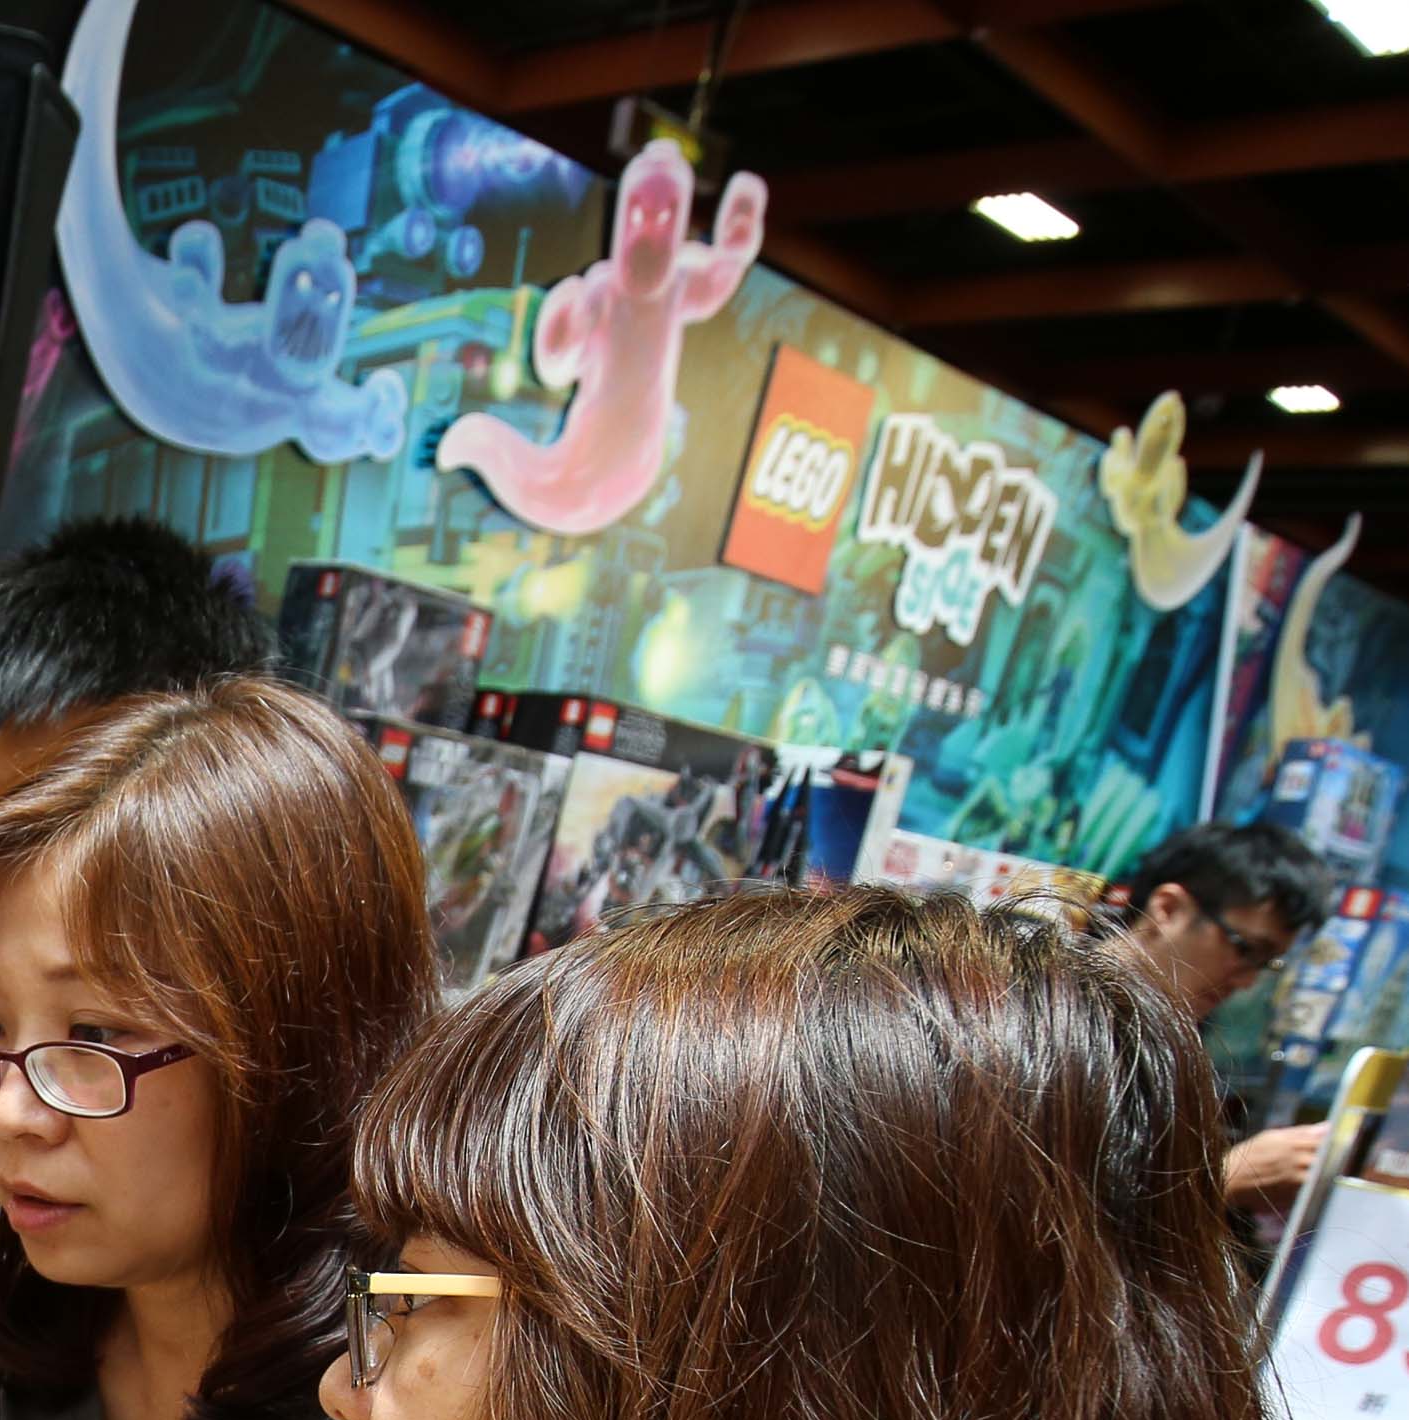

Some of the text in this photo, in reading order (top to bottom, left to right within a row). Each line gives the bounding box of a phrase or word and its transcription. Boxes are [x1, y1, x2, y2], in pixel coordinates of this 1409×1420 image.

[750, 421, 852, 524] LEGO
[859, 414, 1056, 604] HIDDEN
[1316, 1260, 1409, 1376] 8
